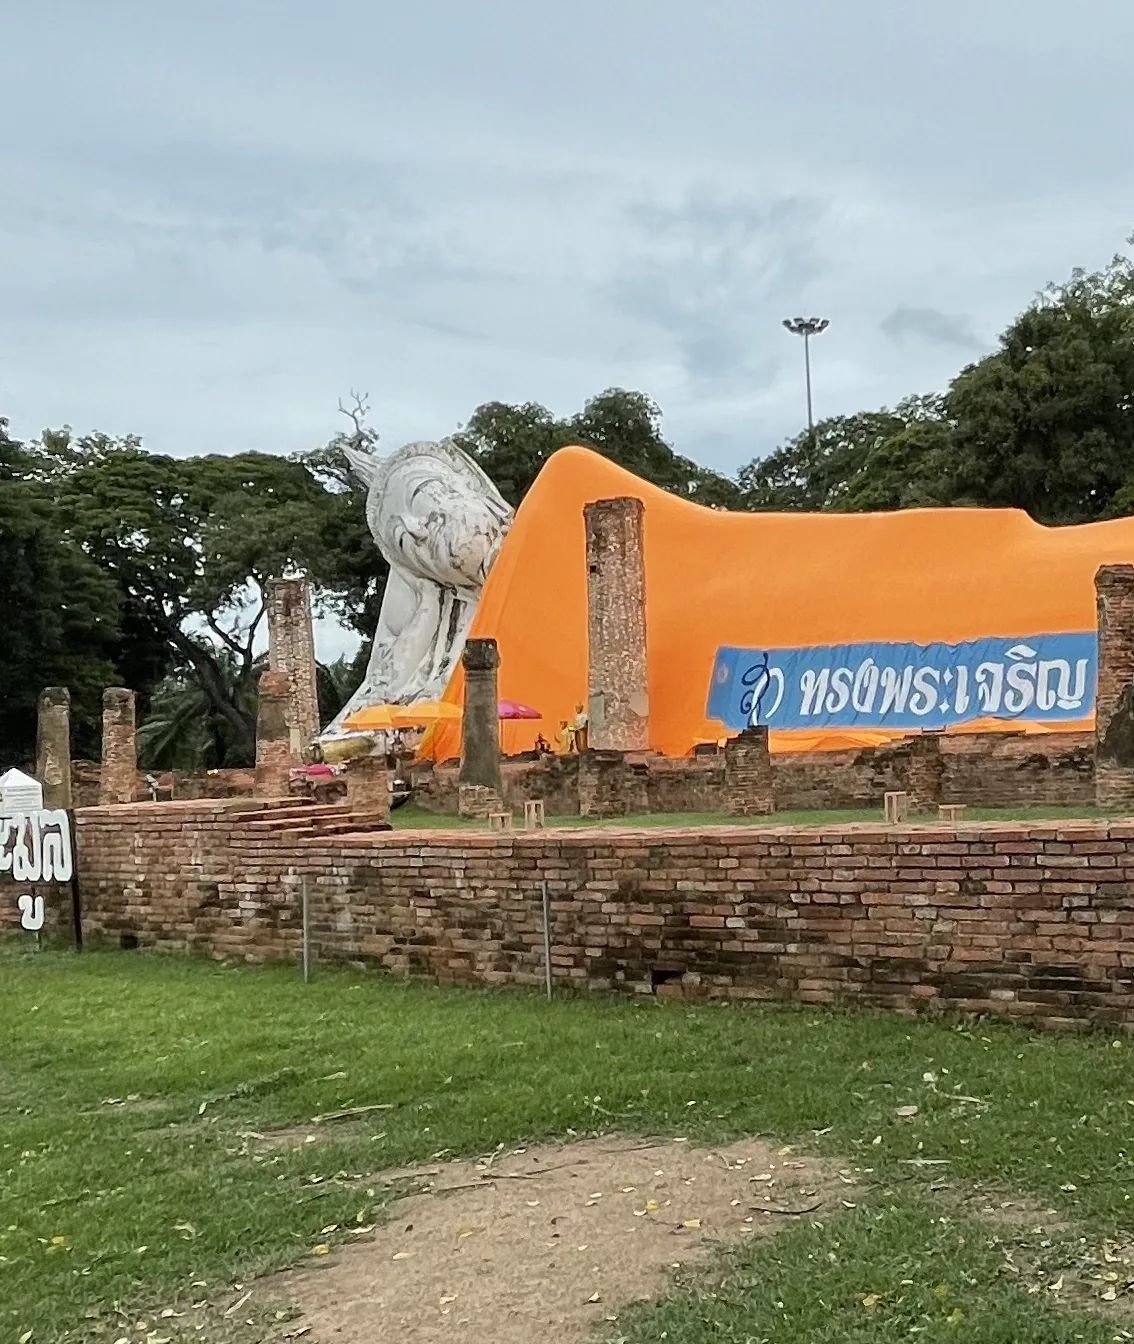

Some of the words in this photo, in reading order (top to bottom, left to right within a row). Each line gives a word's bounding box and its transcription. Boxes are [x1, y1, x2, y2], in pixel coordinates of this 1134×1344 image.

[799, 644, 1089, 716] ทรงพระเจริญ
